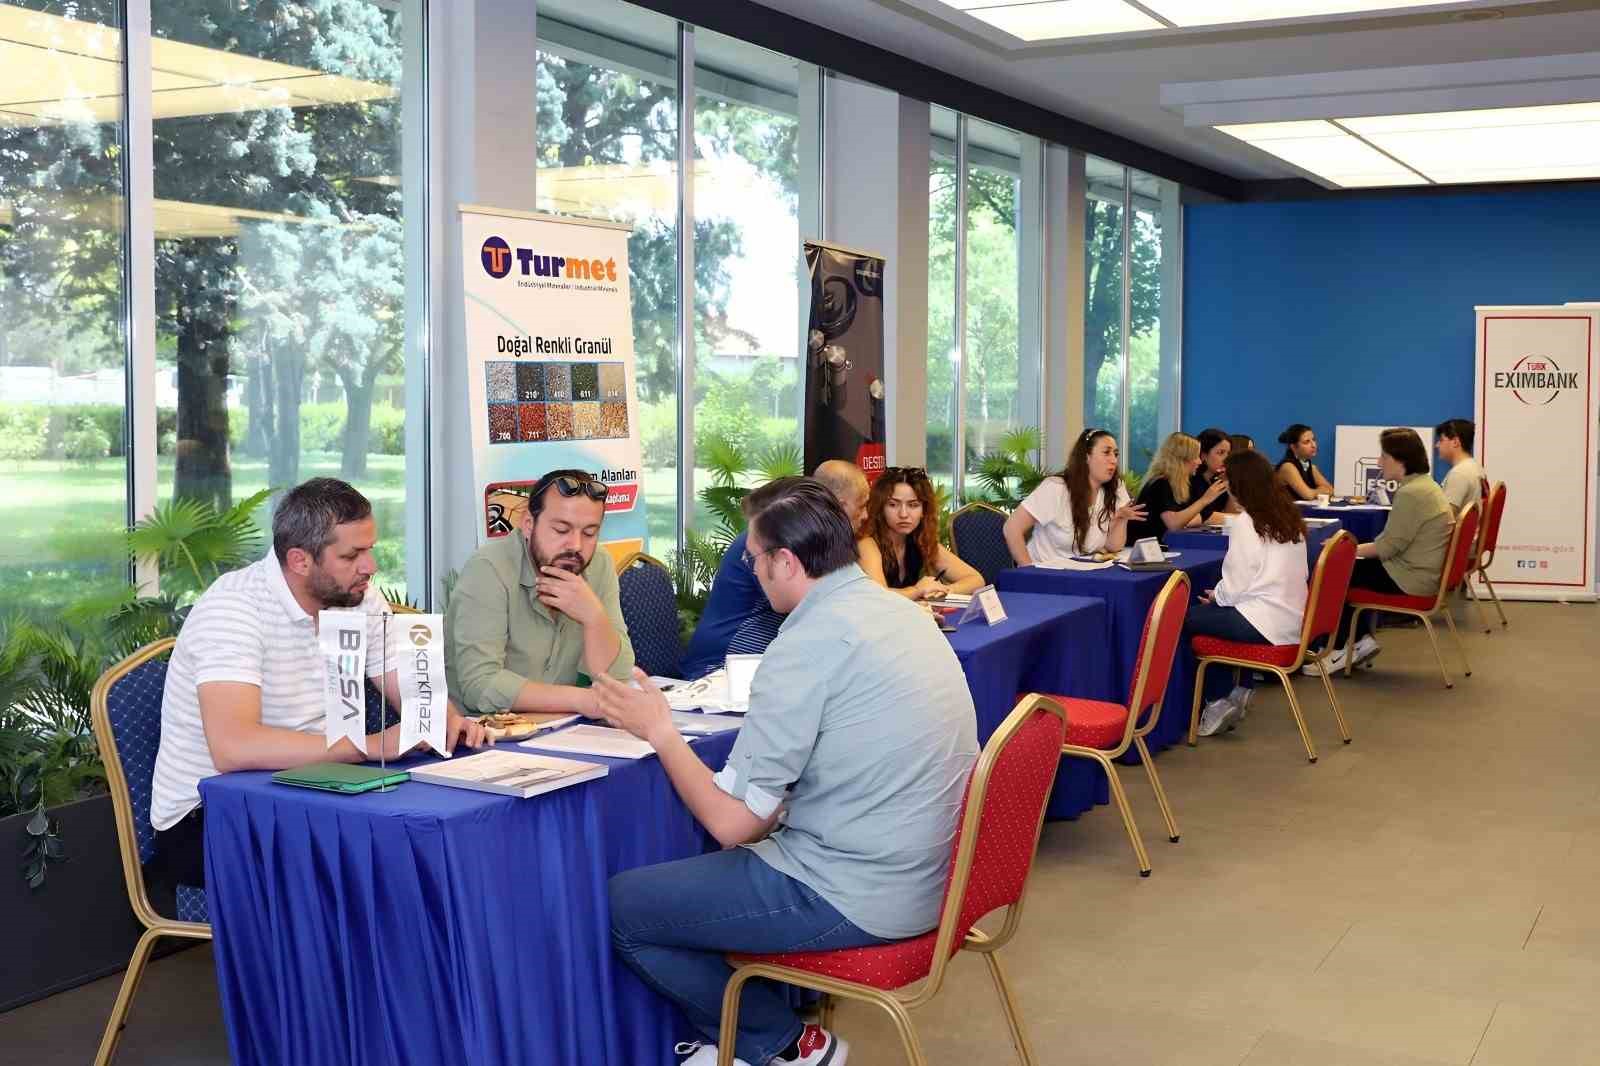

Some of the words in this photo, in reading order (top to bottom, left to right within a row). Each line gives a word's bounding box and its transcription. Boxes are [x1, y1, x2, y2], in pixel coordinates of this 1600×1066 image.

[516, 248, 617, 282] Turmet
[497, 335, 532, 357] Doğal
[536, 337, 572, 354] Renkli
[574, 337, 612, 355] Granül
[1494, 372, 1578, 389] EXIMBANK
